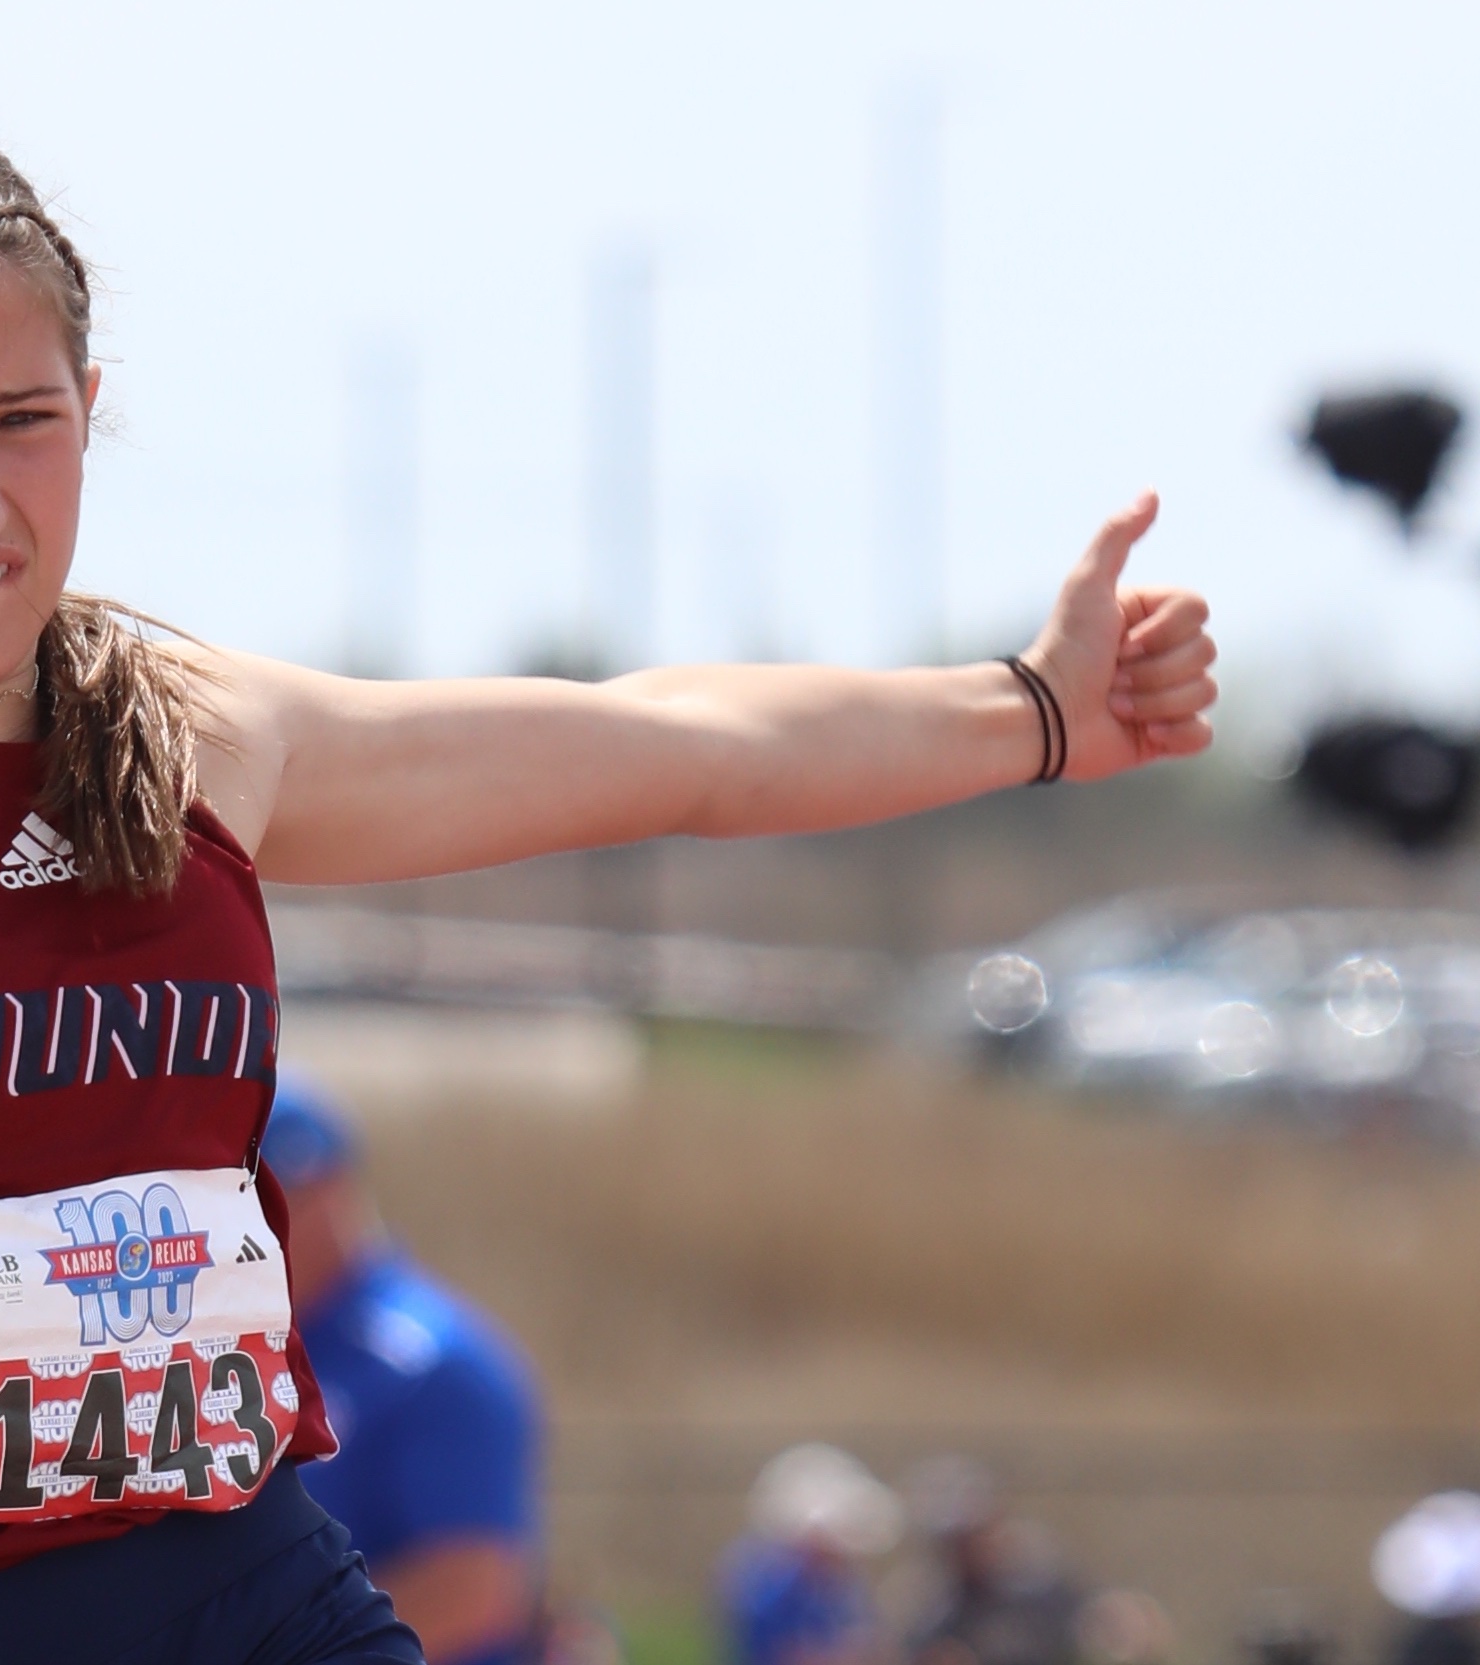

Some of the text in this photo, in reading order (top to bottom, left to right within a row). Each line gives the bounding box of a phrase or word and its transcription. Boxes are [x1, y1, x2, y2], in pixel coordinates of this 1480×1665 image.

[0, 855, 87, 889] adid
[54, 1182, 193, 1346] 100
[60, 1239, 197, 1275] KANSAS RELAYS
[157, 1271, 174, 1284] 2023
